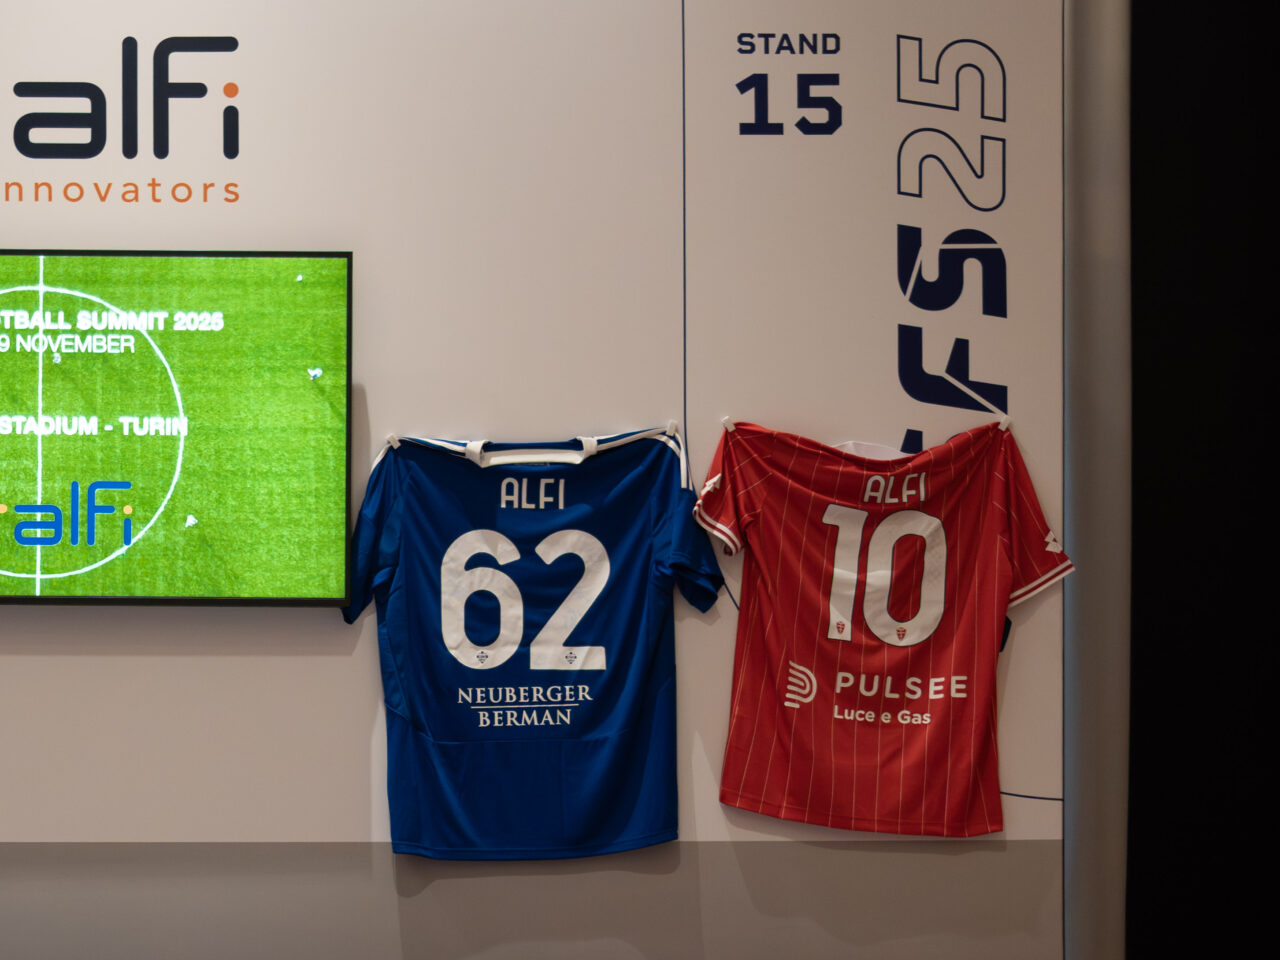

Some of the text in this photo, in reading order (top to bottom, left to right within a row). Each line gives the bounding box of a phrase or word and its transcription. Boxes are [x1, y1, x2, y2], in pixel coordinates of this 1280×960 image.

[736, 33, 841, 55] STAND
[735, 73, 842, 136] 15
[896, 34, 1008, 455] FS25
[77, 311, 168, 331] SUMMIT
[16, 334, 135, 353] NOVEMBER
[119, 417, 188, 436] TURIN
[500, 477, 565, 510] ALFI
[863, 471, 926, 504] ALFI
[821, 504, 947, 648] 10
[441, 529, 611, 670] 62
[457, 684, 594, 705] NEUBERGER
[835, 671, 968, 700] PULSEE
[478, 708, 572, 728] BERMAN
[833, 704, 932, 725] Luce e Gas
